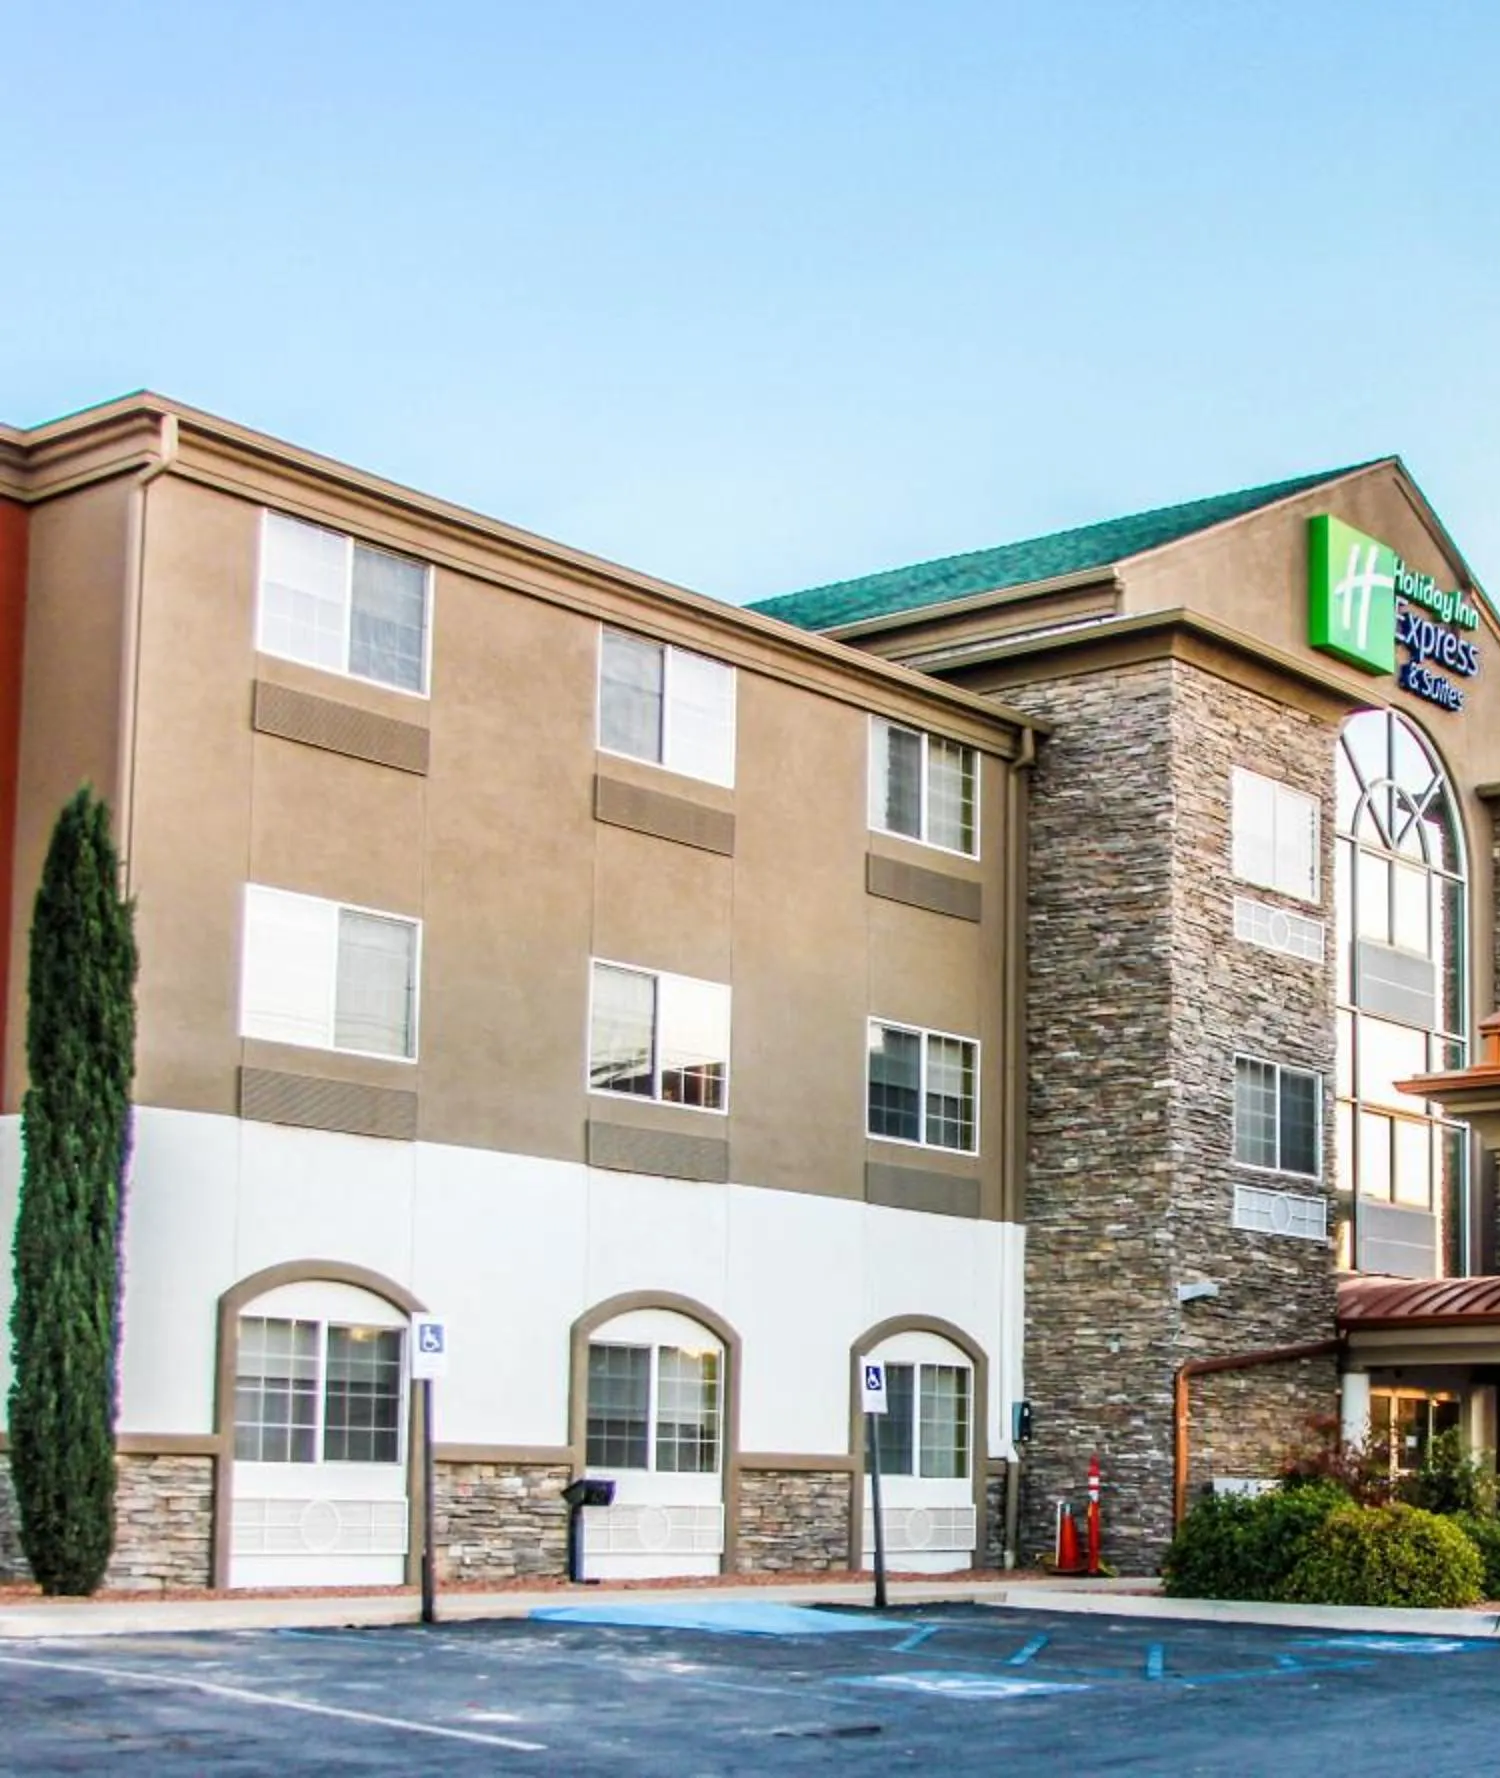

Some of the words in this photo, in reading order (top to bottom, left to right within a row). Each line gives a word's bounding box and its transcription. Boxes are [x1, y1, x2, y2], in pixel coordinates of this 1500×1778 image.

[1394, 557, 1452, 622] Holiday
[1455, 591, 1479, 630] Inn
[1395, 597, 1480, 676] Express
[1424, 671, 1465, 711] Suites
